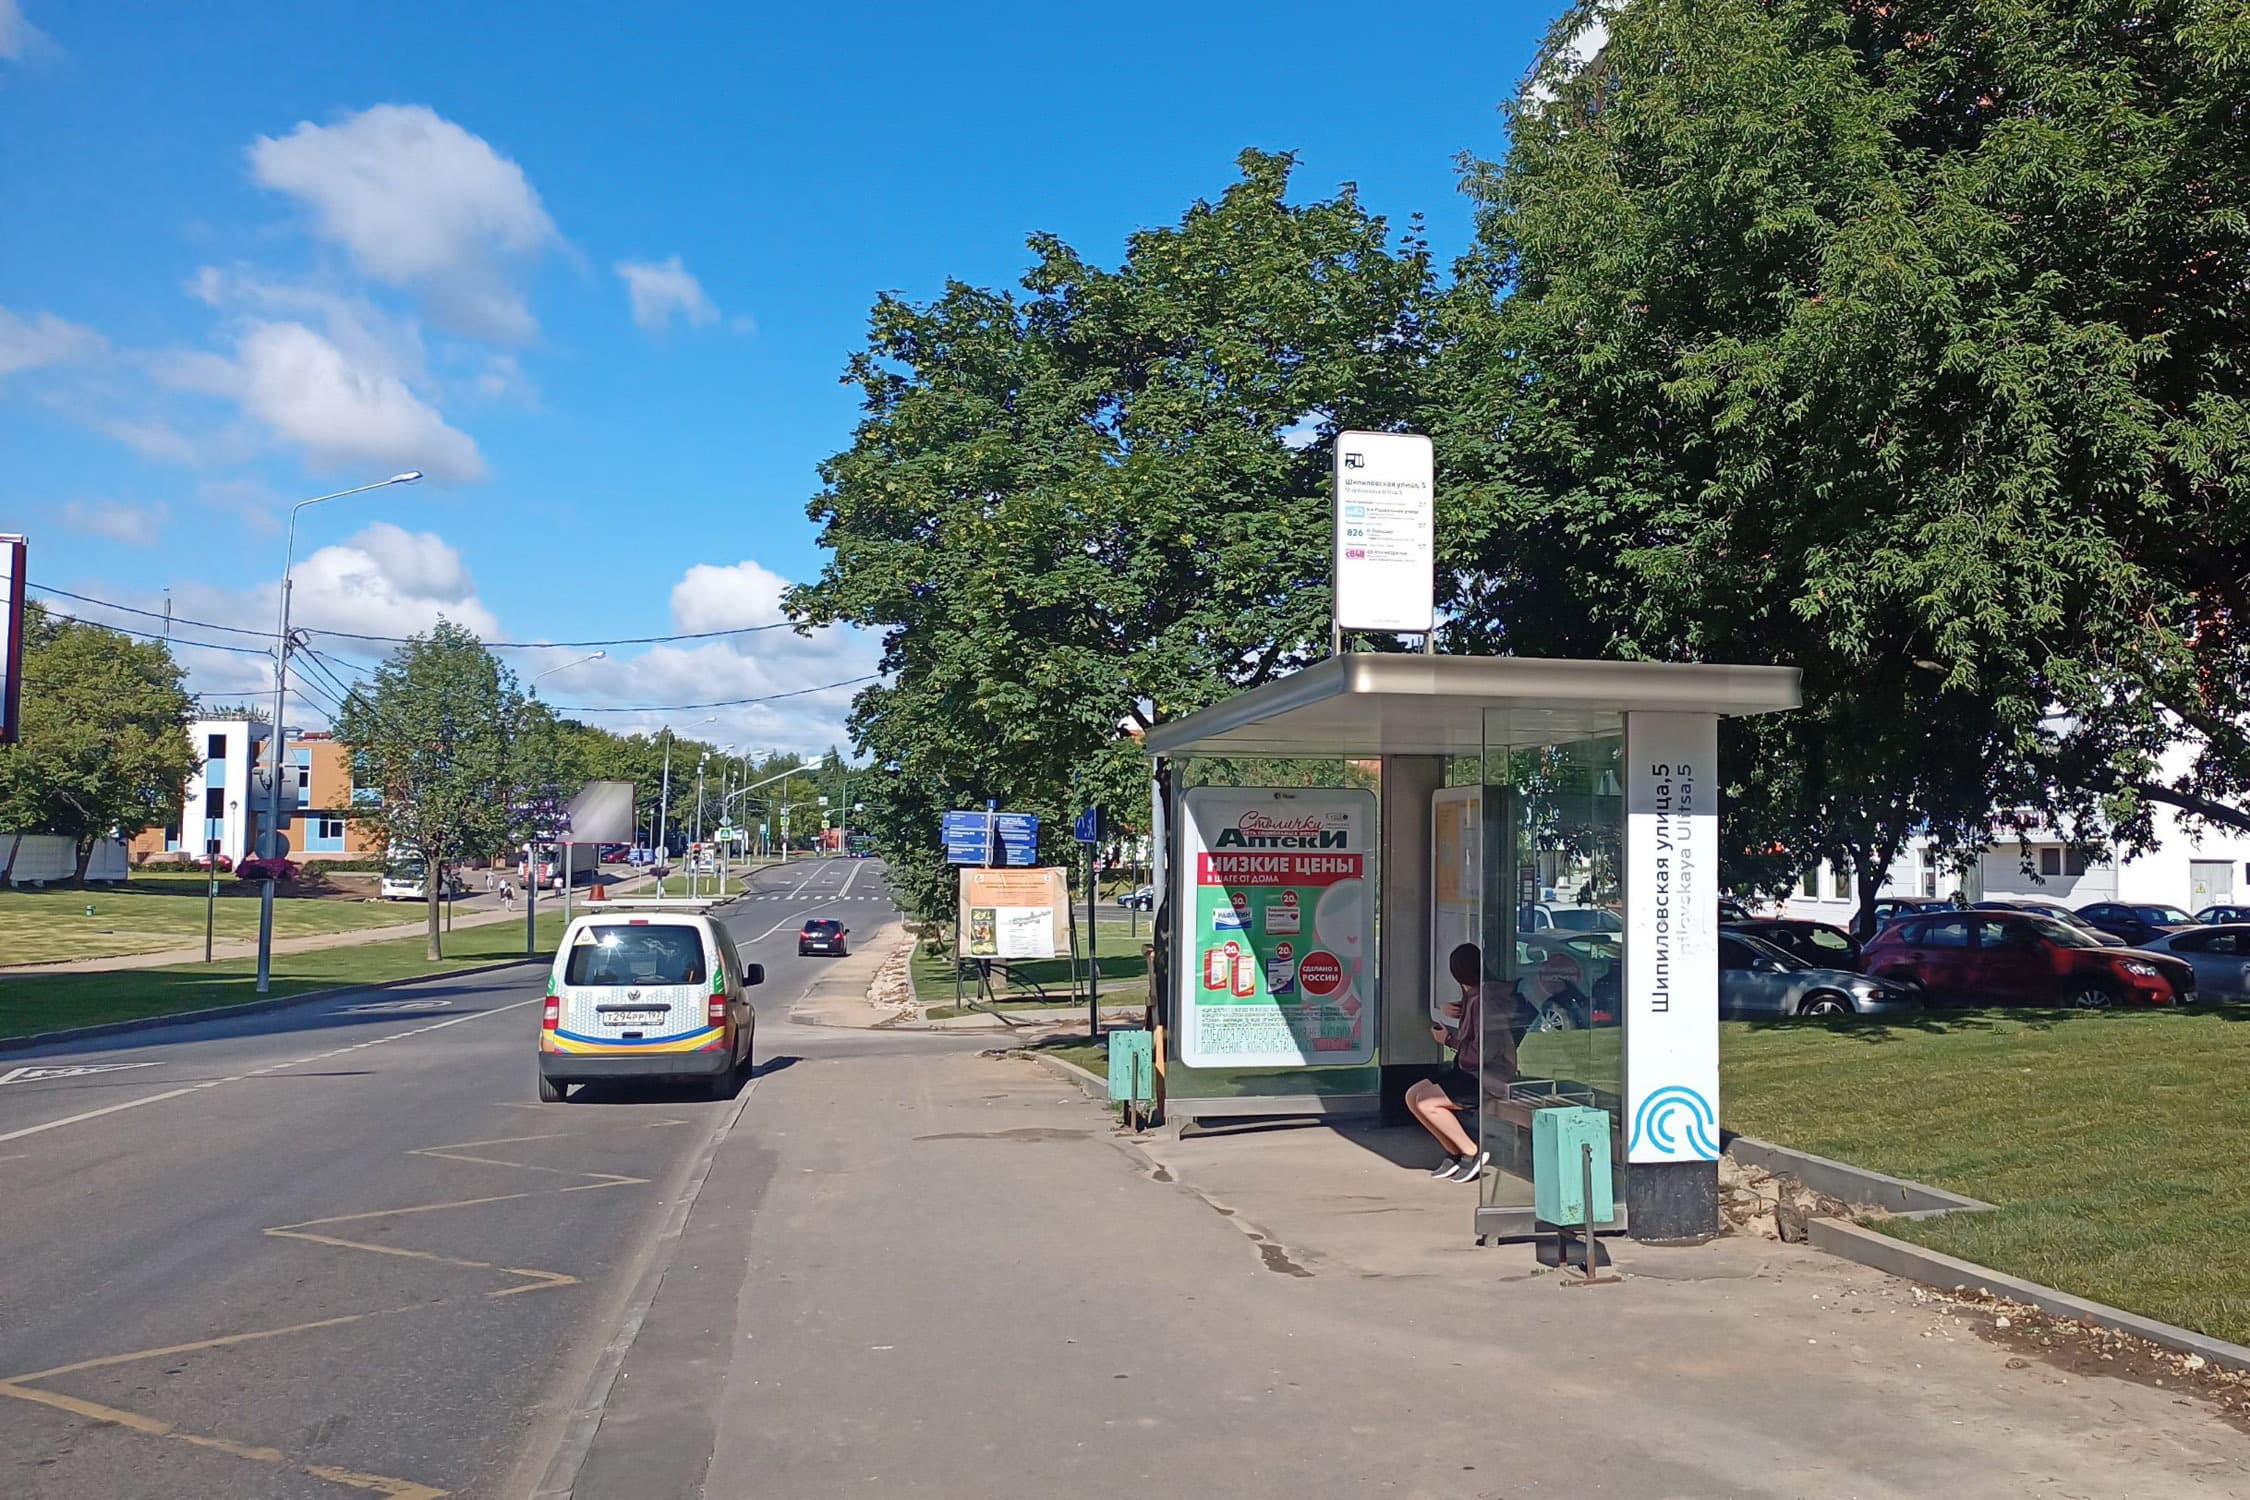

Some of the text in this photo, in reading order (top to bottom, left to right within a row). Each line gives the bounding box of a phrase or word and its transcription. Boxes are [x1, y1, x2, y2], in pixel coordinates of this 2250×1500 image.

[1346, 528, 1364, 537] 826
[1238, 810, 1325, 830] Столички
[1207, 855, 1354, 875] НИЗКИЕ ЦЕНЫ
[1214, 875, 1238, 884] ШАГЕ
[1239, 875, 1250, 884] ОТ
[1251, 875, 1280, 884] ДОМА
[1651, 858, 1670, 1013] Шипиловская
[1302, 974, 1339, 982] РОССИИ
